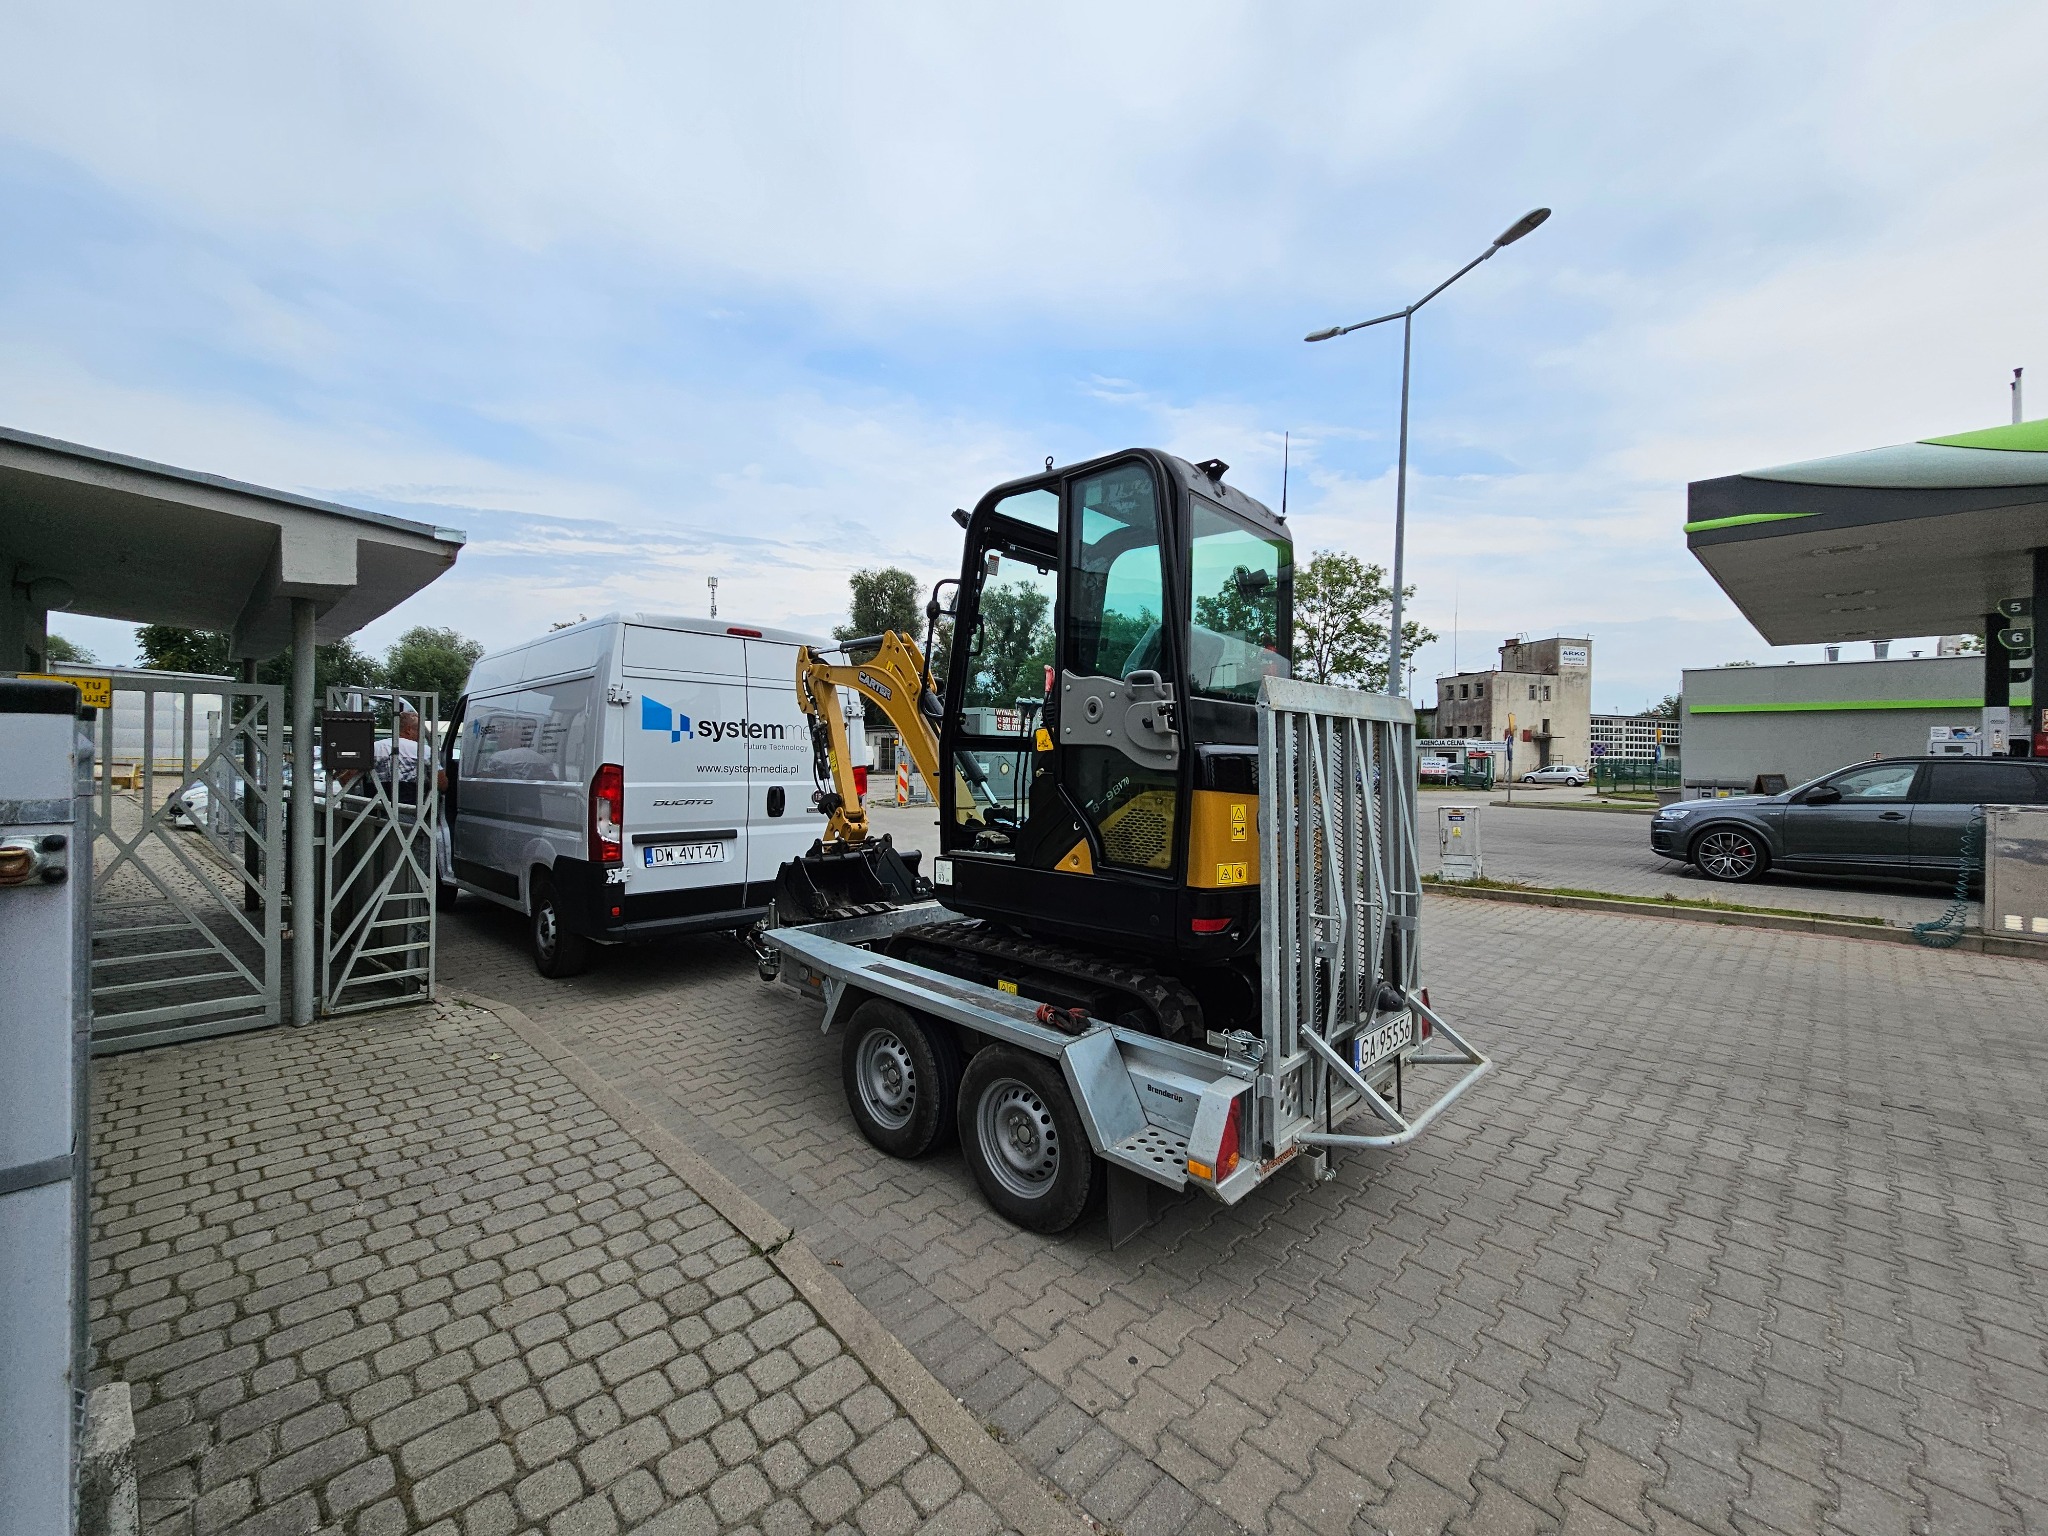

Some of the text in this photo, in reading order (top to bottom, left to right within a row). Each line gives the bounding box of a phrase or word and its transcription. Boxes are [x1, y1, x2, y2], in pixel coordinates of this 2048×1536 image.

[2010, 602, 2021, 612] 5
[2012, 632, 2024, 643] 6
[84, 681, 101, 690] TU
[858, 671, 892, 701] CARTER
[743, 742, 809, 753] Future Technology
[696, 764, 799, 775] www.system-media.pl
[653, 799, 714, 807] DUCATO
[655, 844, 719, 863] DW 4VT47
[1361, 1015, 1411, 1065] GA 95556
